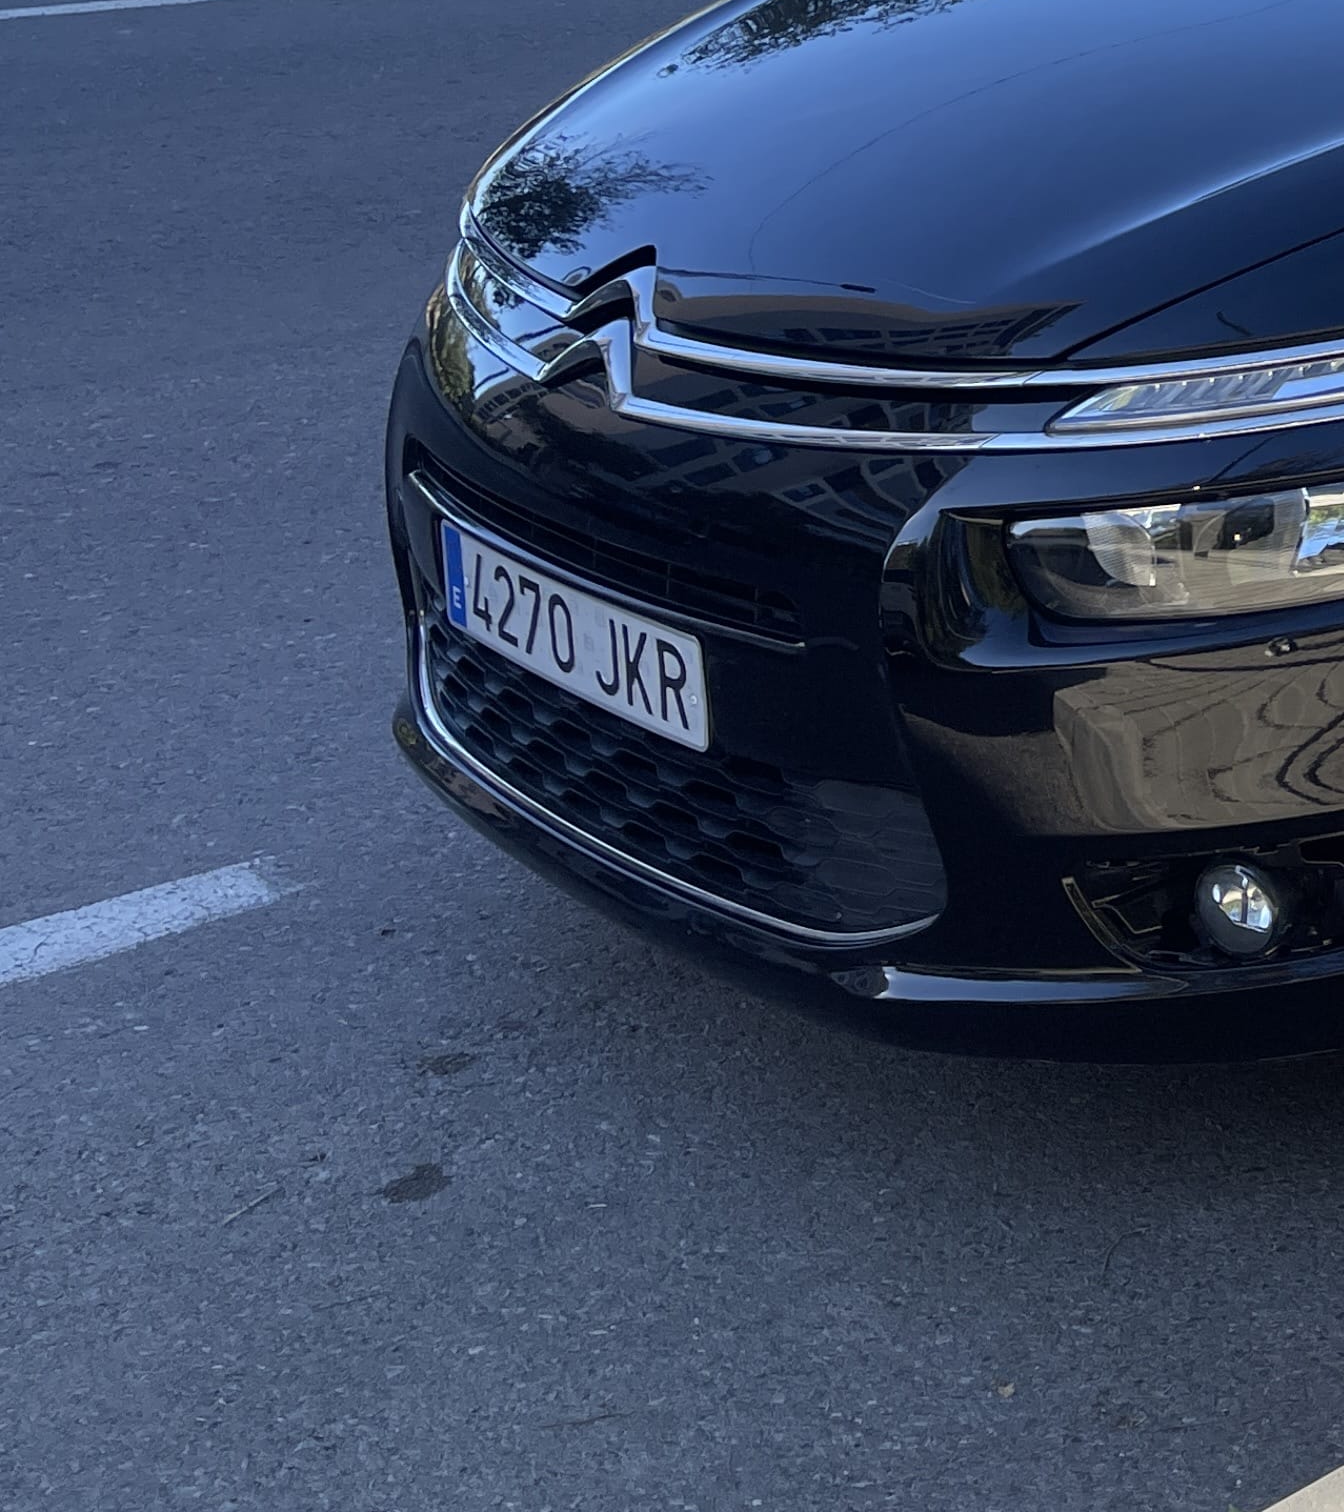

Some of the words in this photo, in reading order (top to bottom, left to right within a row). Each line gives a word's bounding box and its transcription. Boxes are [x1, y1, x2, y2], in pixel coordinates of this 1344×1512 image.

[452, 585, 462, 609] E
[473, 554, 575, 673] 4270
[596, 619, 690, 730] JKR
